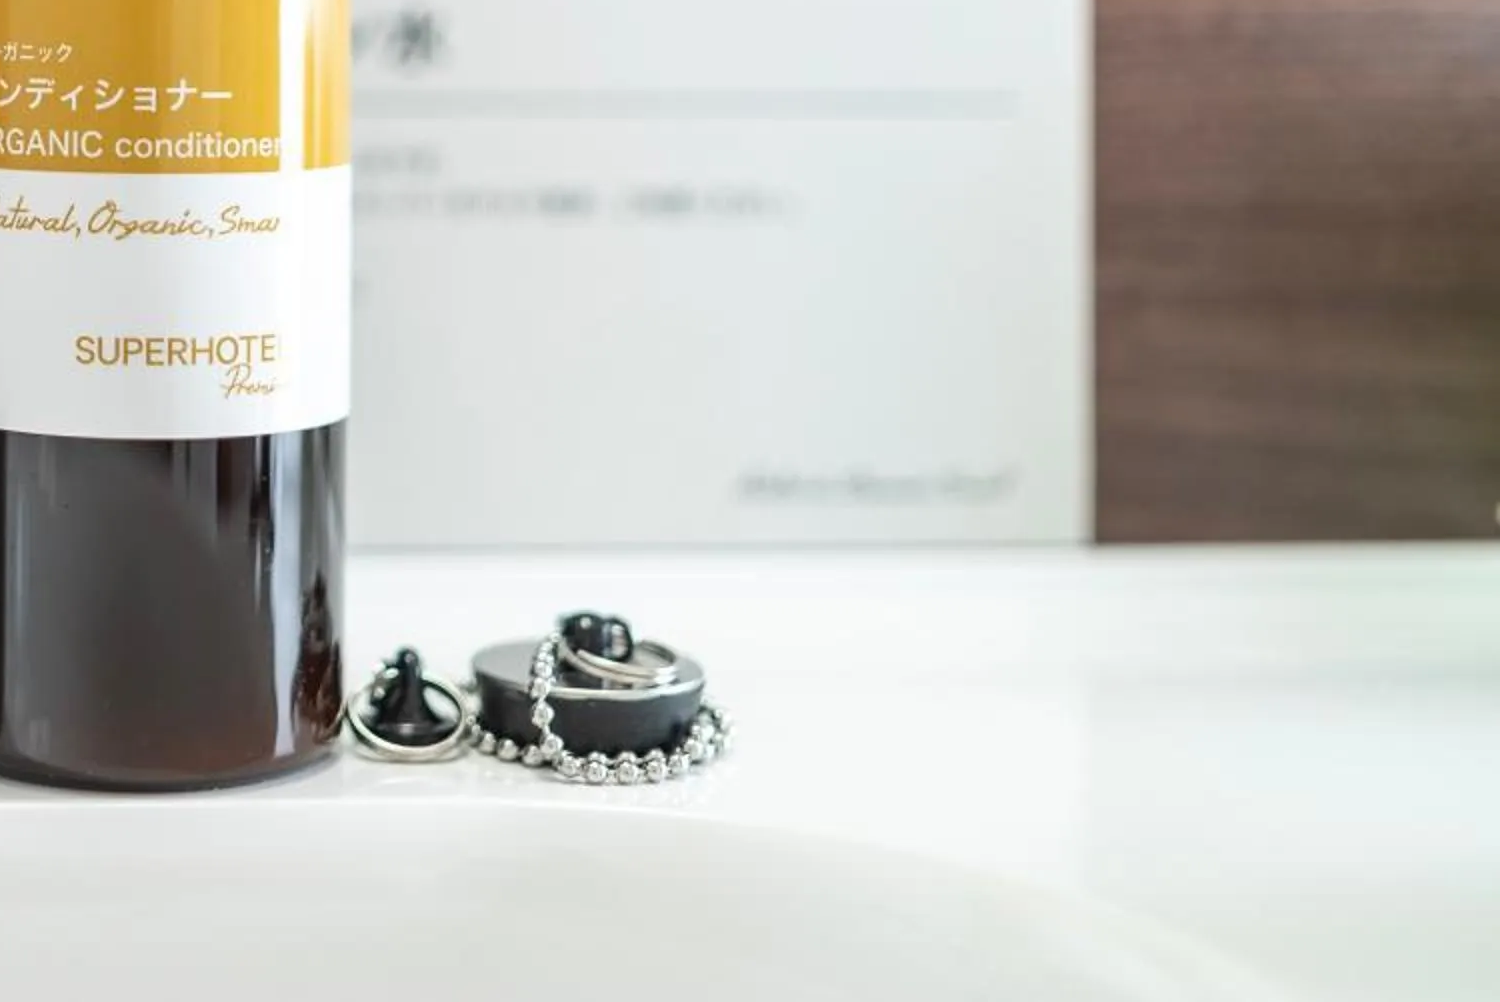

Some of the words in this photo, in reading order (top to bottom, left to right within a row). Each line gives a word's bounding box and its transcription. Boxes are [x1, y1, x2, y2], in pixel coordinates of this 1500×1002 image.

[88, 200, 214, 240] Organic,
[219, 204, 280, 235] Sma
[75, 333, 277, 366] SUPERHOTE
